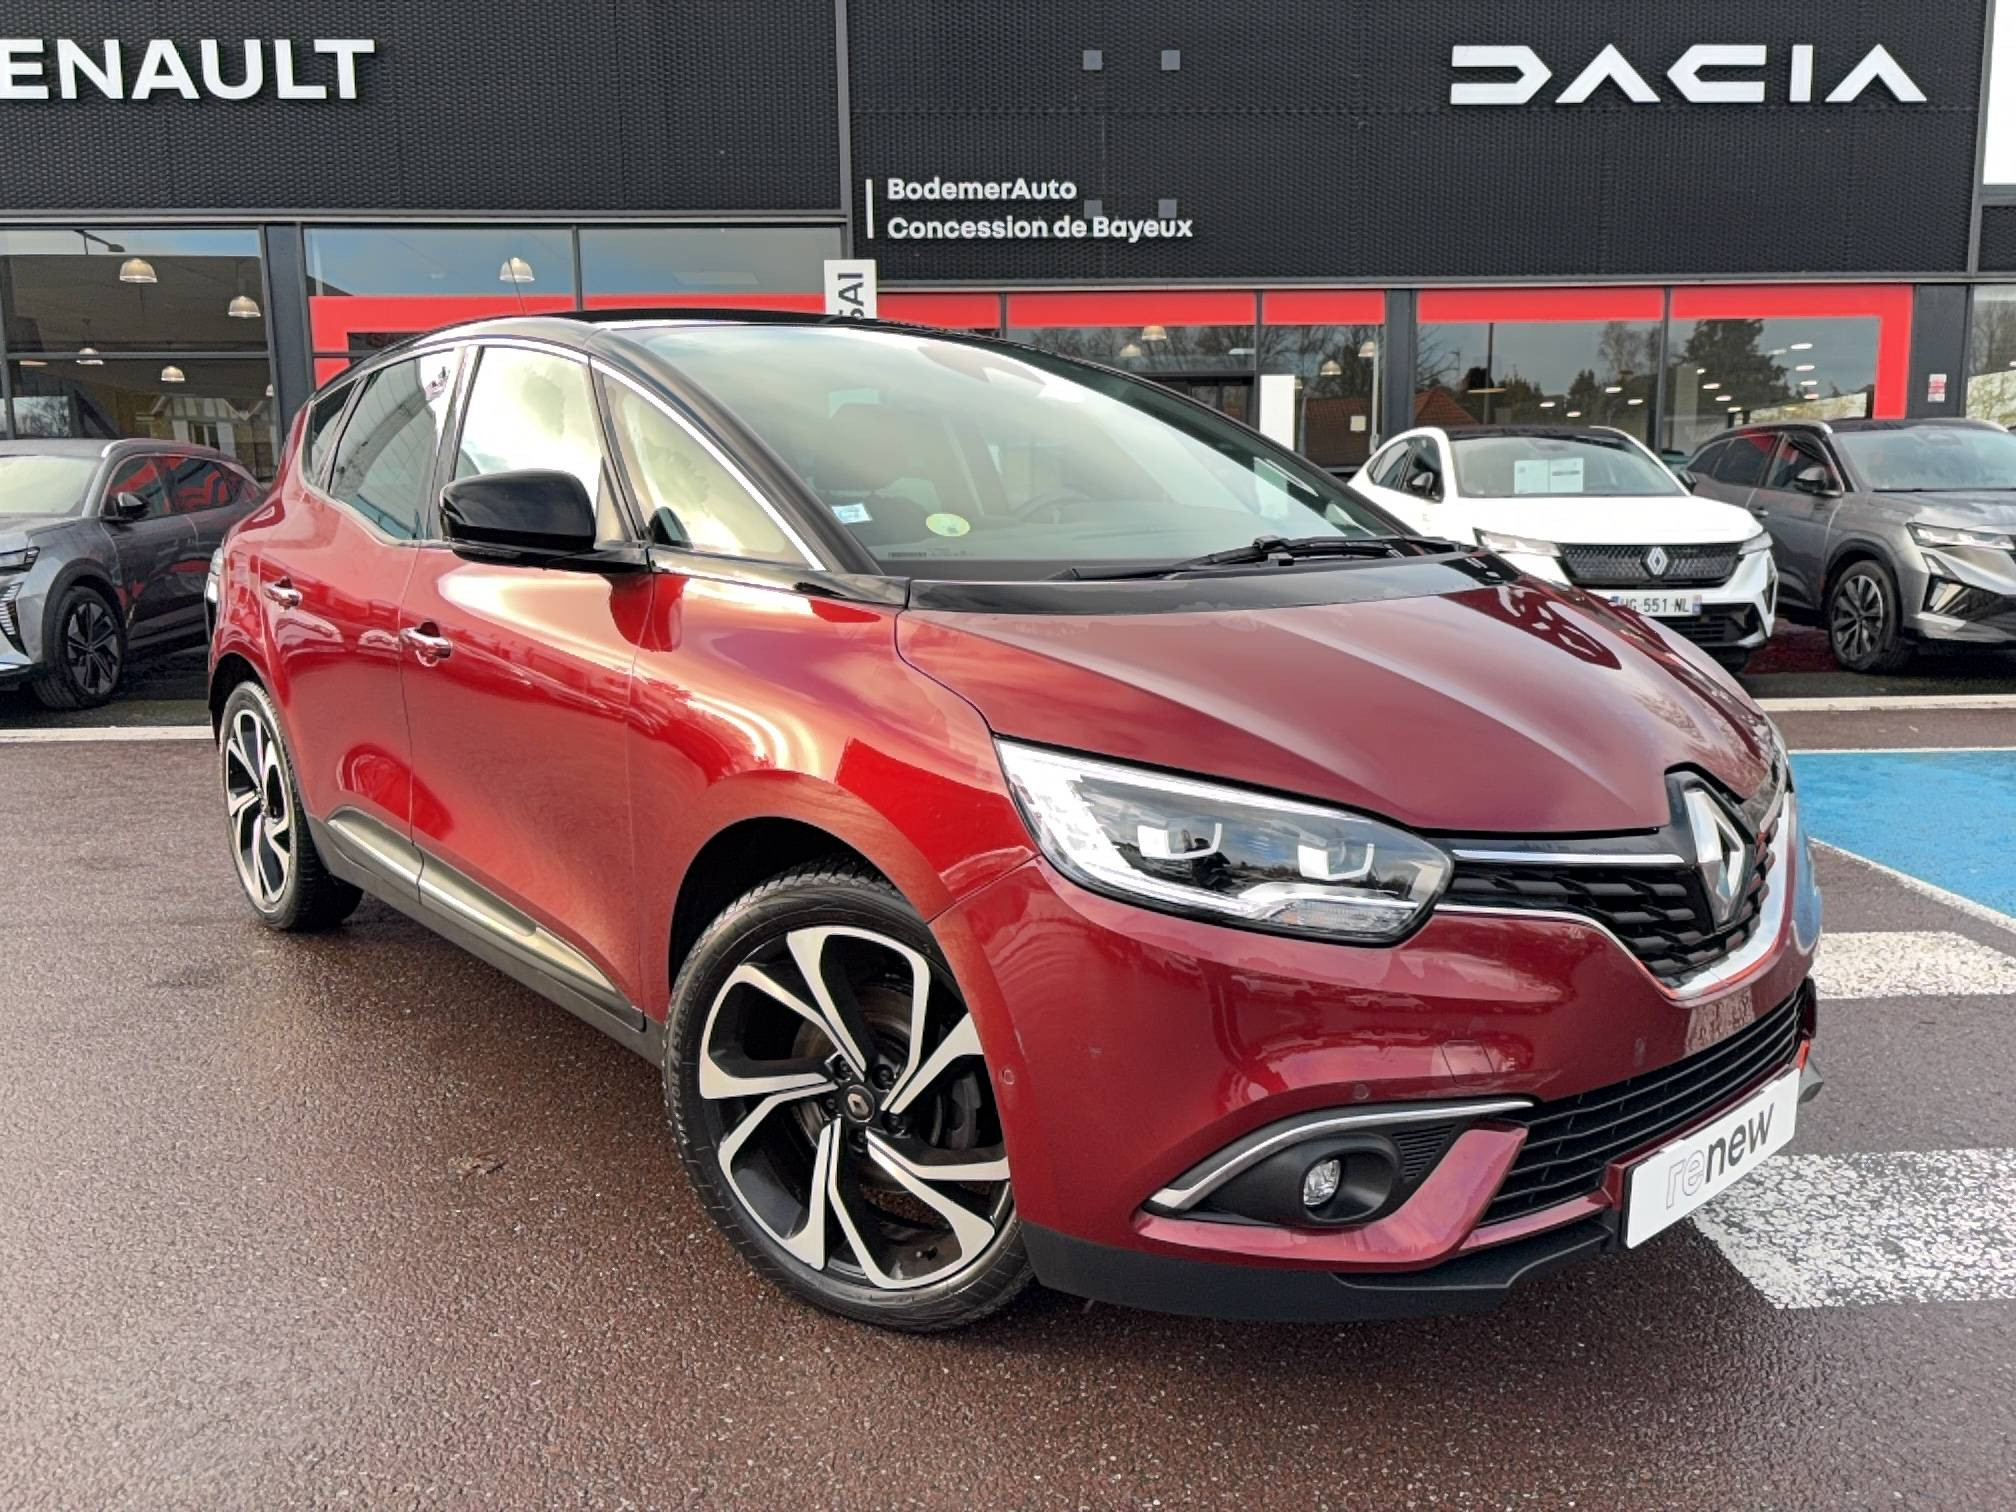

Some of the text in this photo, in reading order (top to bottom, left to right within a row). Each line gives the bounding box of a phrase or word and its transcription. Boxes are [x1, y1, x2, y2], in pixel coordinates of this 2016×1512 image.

[1450, 43, 1928, 105] DACIA
[887, 176, 1077, 200] BodemerAuto
[887, 214, 1193, 243] Concession de Bayeux
[1665, 1102, 1775, 1210] renew
